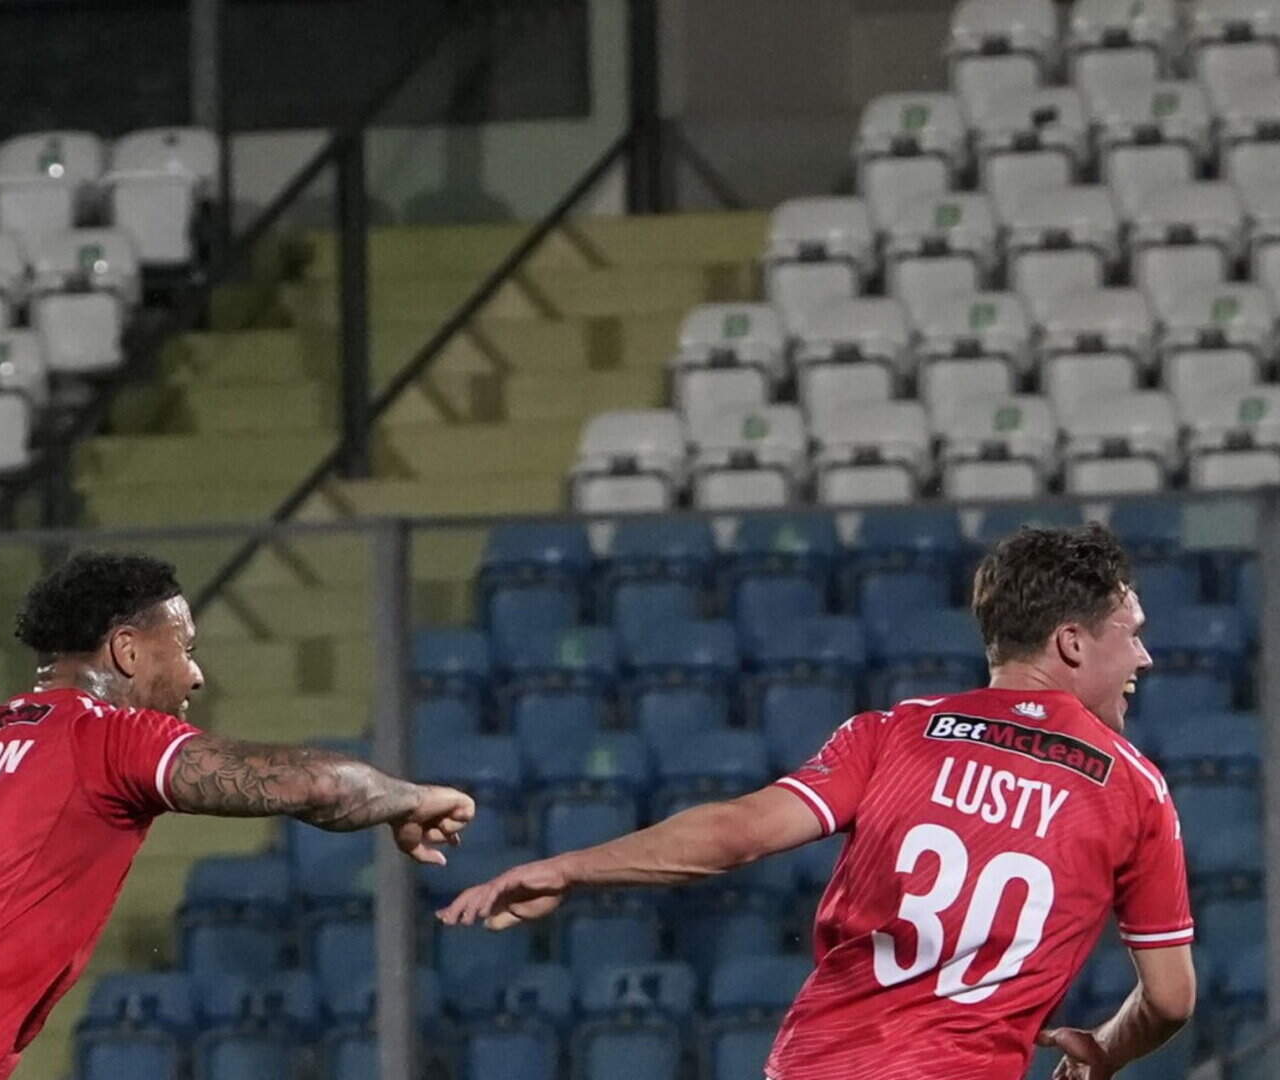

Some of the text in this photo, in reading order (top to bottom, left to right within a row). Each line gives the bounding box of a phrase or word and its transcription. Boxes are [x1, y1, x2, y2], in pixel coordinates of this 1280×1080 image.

[930, 716, 1106, 780] BetMcLean
[930, 756, 1070, 839] LUSTY
[872, 823, 1055, 1004] 30
